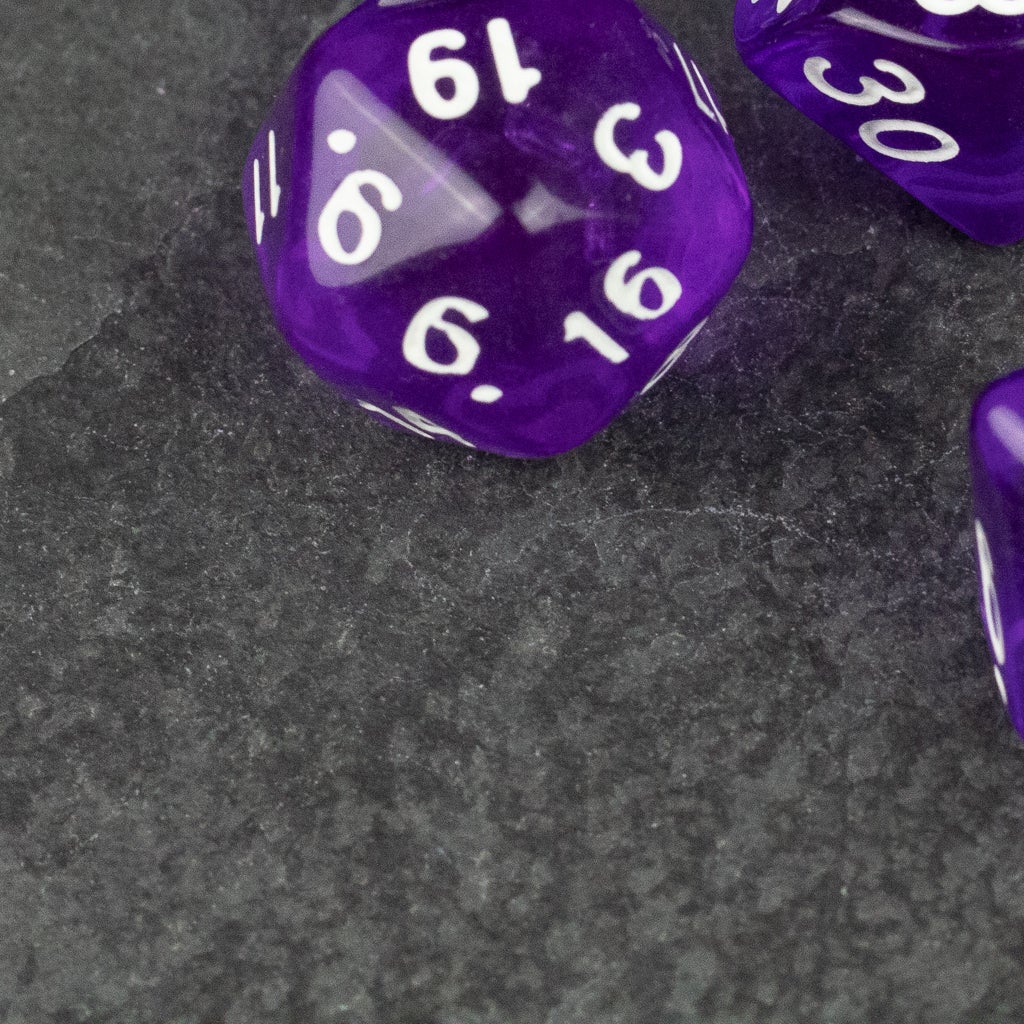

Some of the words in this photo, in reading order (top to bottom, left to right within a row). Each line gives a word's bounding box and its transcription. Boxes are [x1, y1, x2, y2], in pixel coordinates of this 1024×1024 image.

[406, 16, 543, 121] 19
[593, 101, 684, 192] 3
[563, 249, 684, 365] 16
